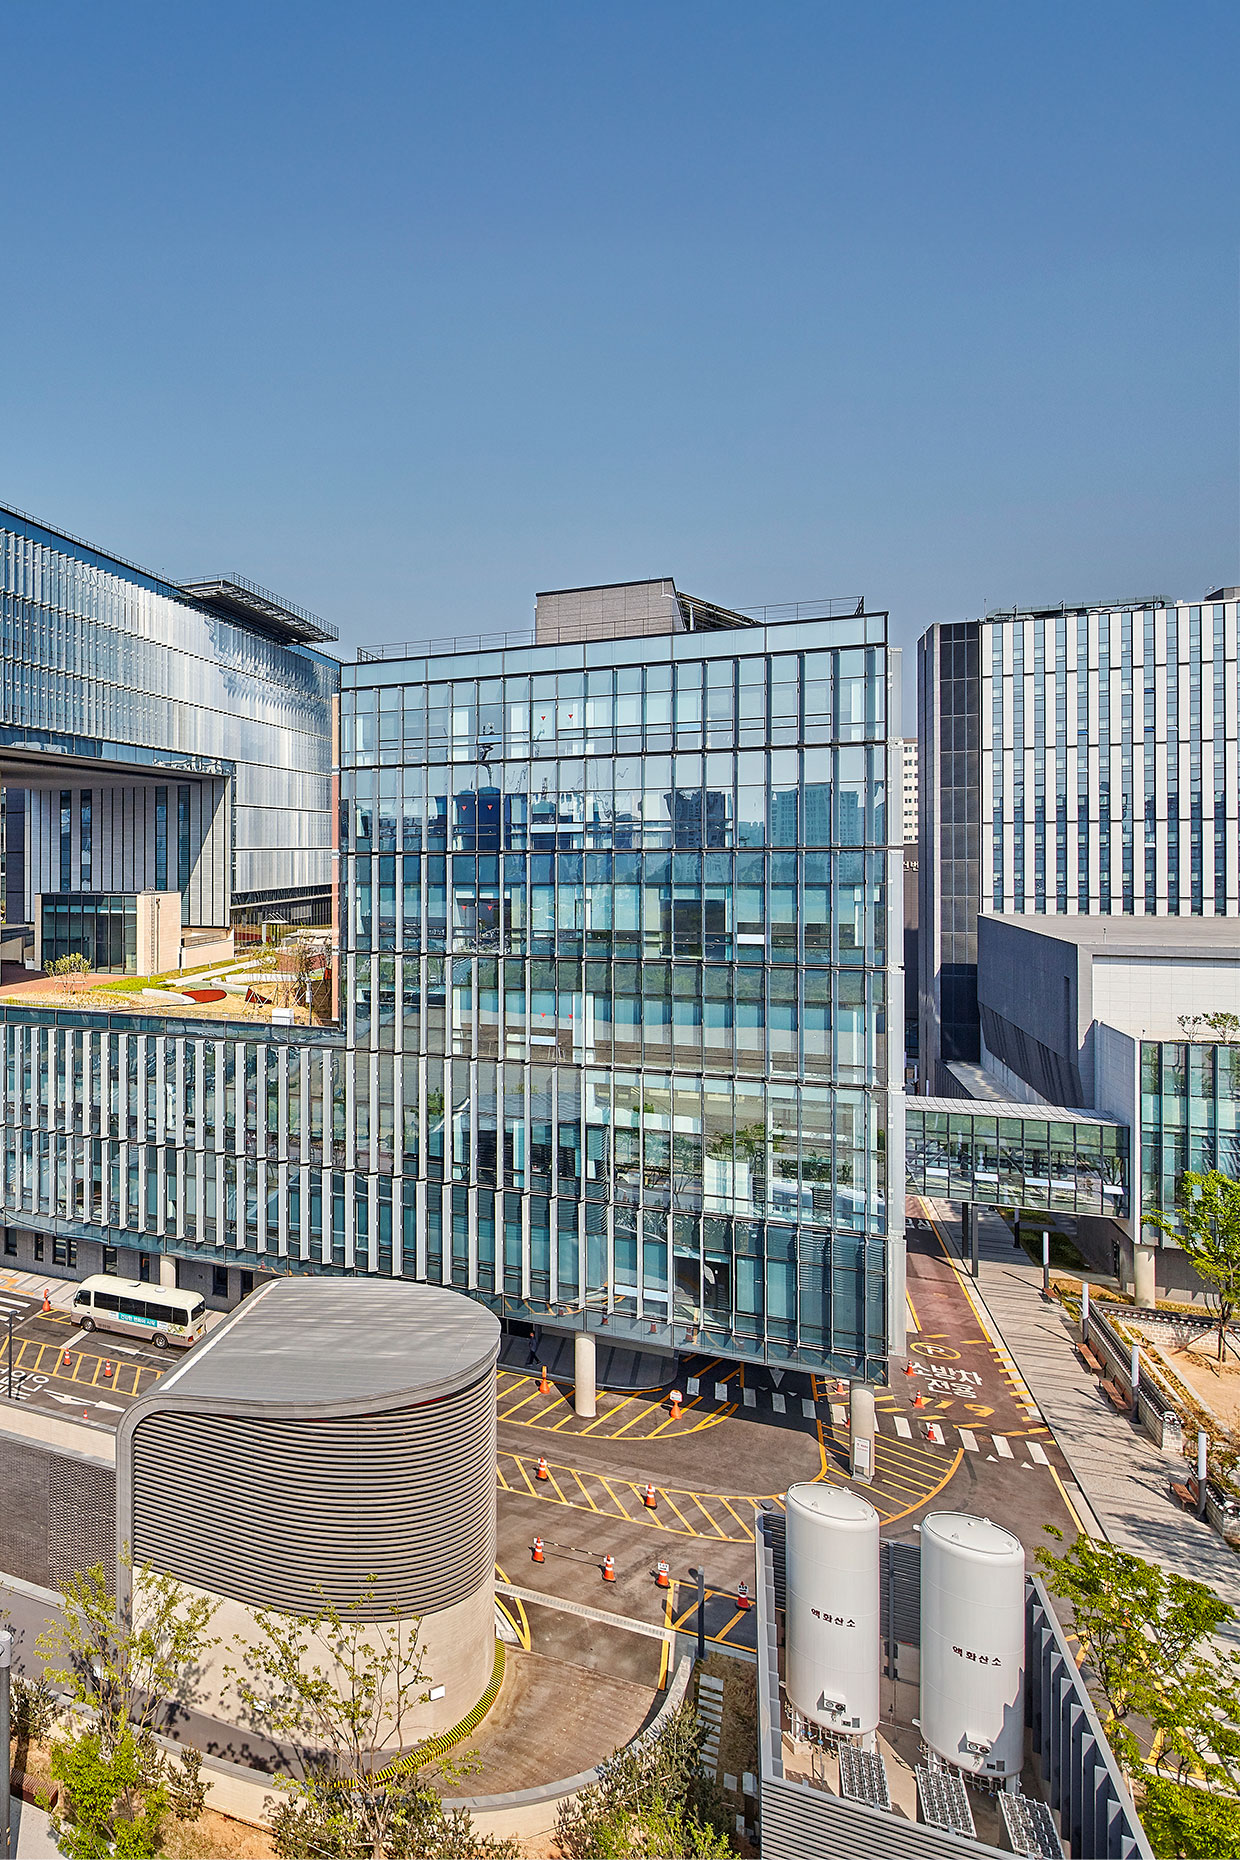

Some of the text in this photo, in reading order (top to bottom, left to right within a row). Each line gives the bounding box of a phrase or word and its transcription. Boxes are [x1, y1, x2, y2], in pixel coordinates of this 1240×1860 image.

[912, 1361, 983, 1386] 소방차
[924, 1377, 977, 1399] 전용
[811, 1608, 856, 1628] 액화산소
[952, 1645, 1002, 1667] 액화산소
